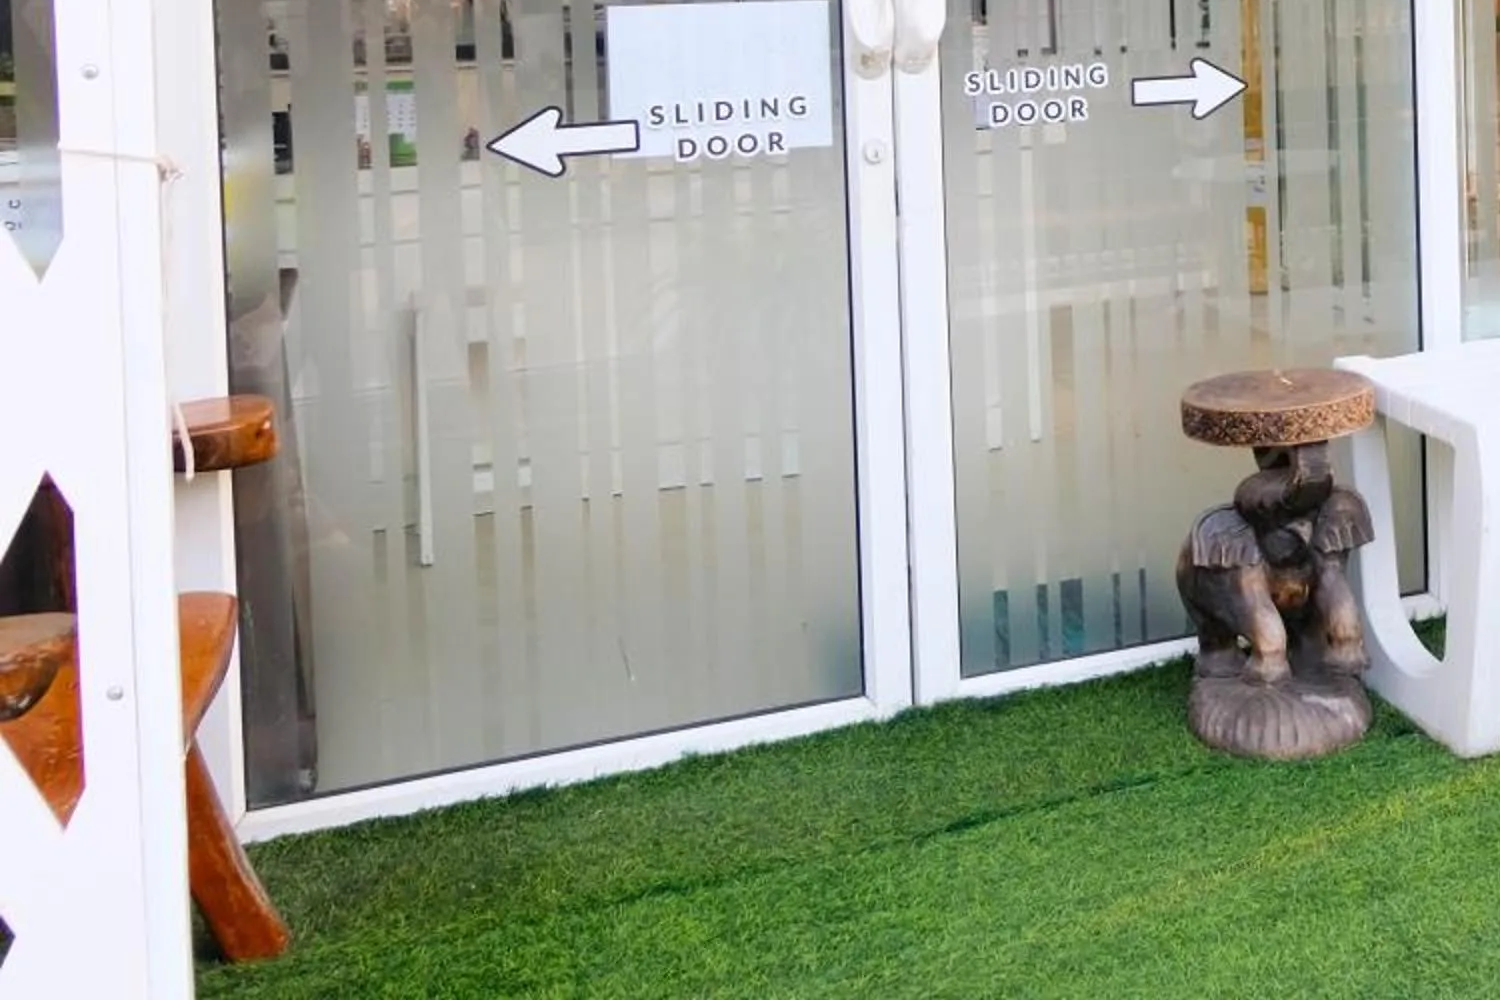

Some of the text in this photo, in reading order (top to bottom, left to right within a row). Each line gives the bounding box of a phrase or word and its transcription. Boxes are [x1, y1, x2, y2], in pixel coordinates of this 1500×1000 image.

[965, 64, 1107, 93] SLIDING
[650, 96, 808, 126] SLIDING
[990, 99, 1087, 124] DOOR
[677, 131, 786, 160] DOOR
